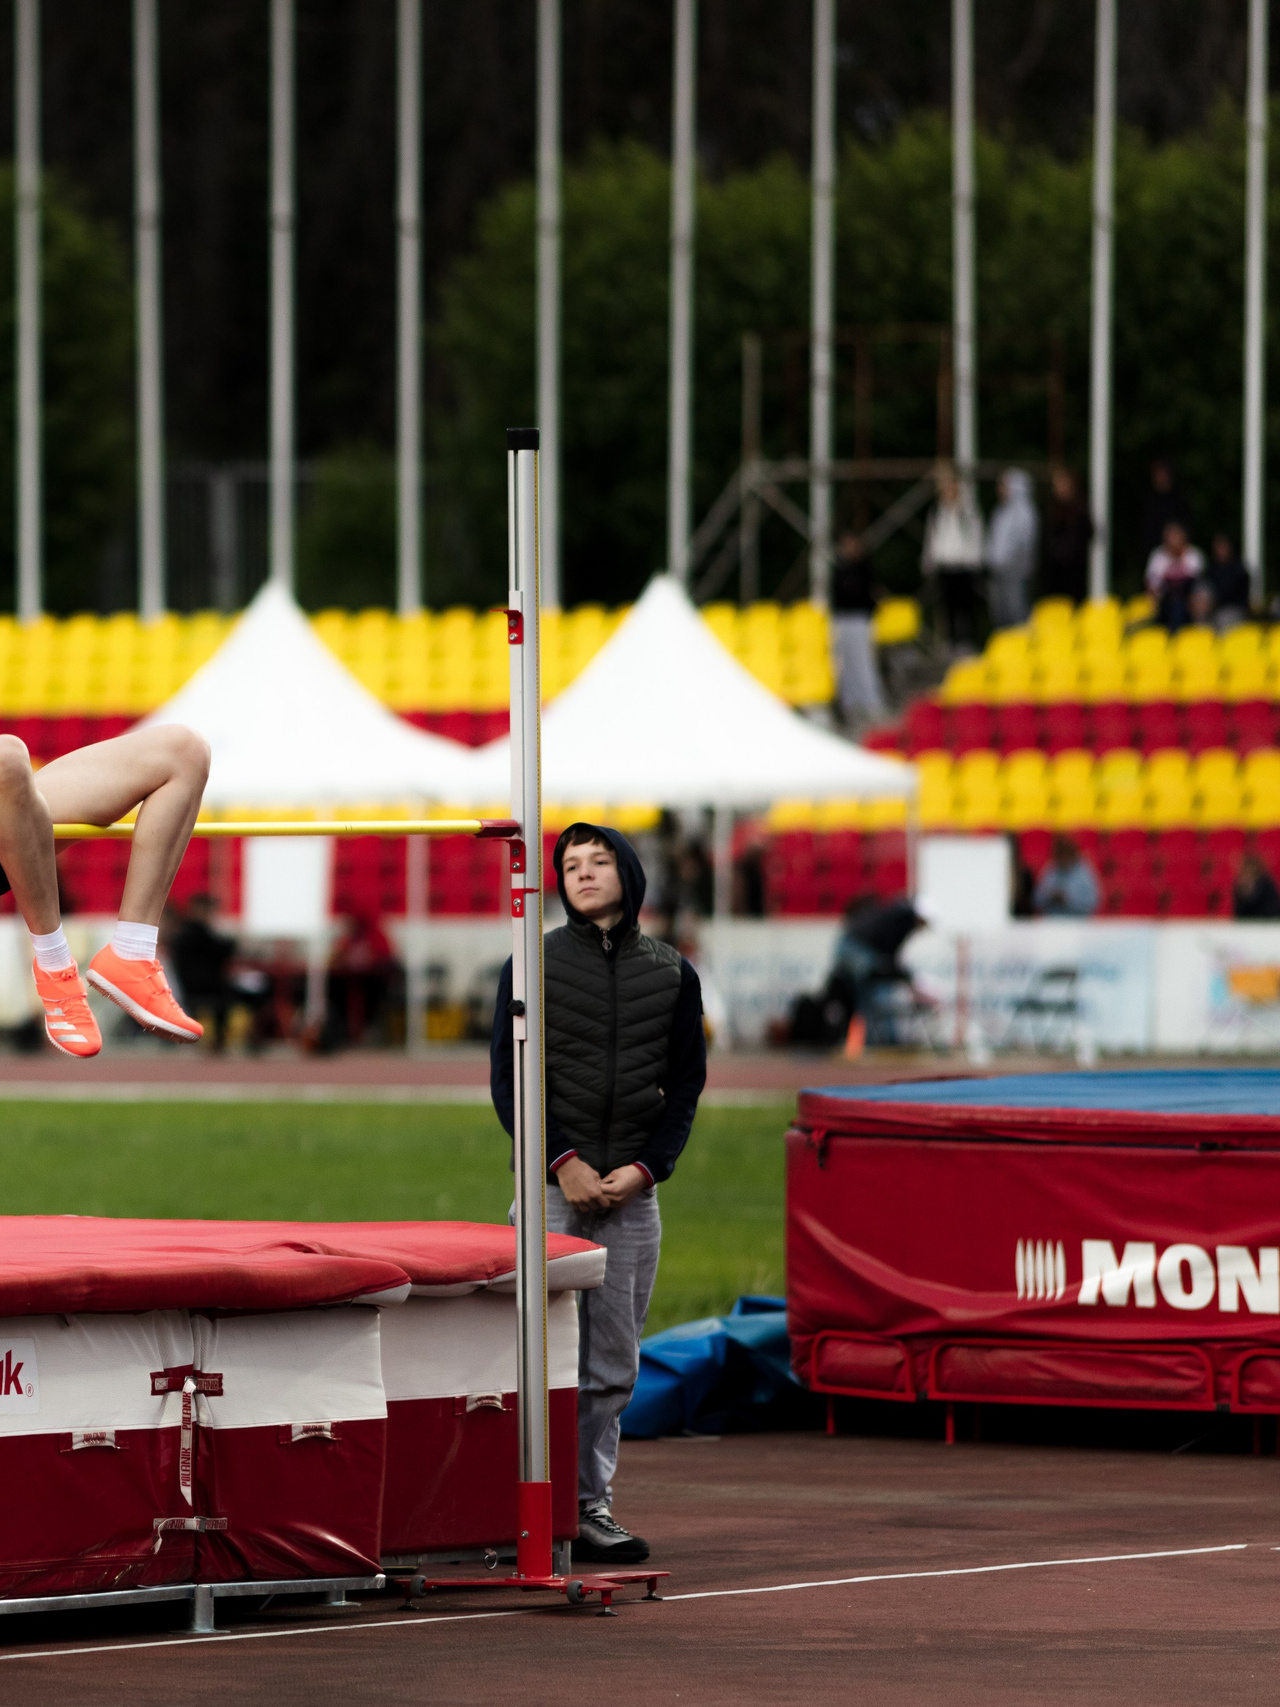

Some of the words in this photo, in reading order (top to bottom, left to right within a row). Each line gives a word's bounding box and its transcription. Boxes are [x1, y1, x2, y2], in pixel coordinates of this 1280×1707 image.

[1077, 1238, 1280, 1314] MON
[182, 1391, 192, 1430] POLANIK
[181, 1447, 191, 1487] POLANIK
